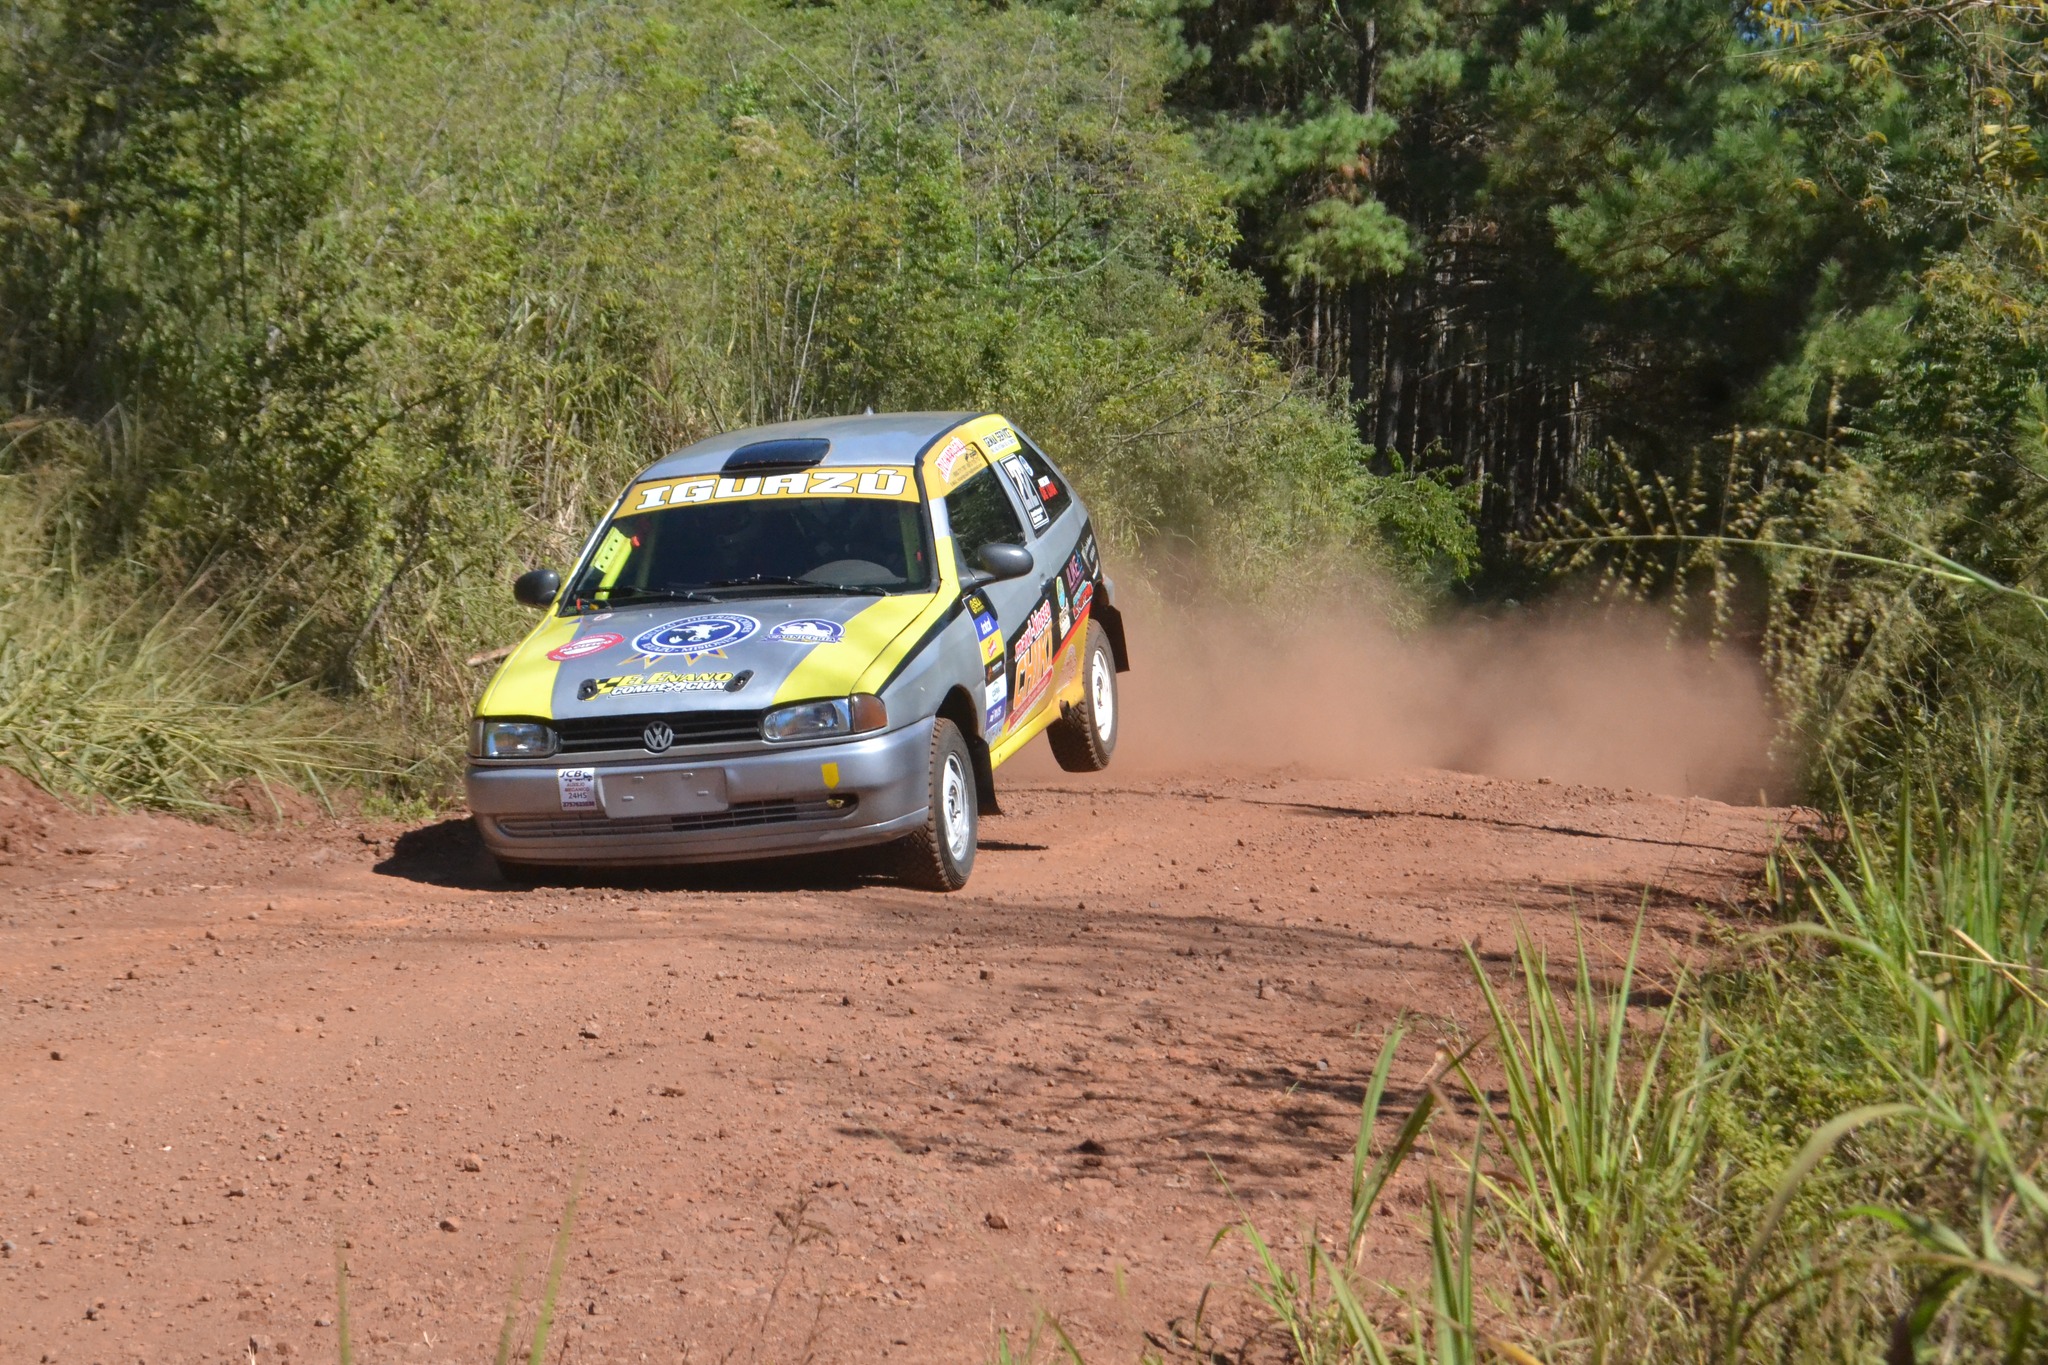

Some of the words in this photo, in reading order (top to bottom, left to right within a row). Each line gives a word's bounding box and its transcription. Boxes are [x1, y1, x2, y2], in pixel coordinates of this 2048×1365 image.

[636, 469, 906, 510] IGUAZÚ
[681, 636, 738, 652] MISIONES
[1013, 619, 1053, 710] CHIKI
[618, 674, 644, 686] EL
[646, 671, 734, 686] ENANO
[560, 770, 582, 778] JCB
